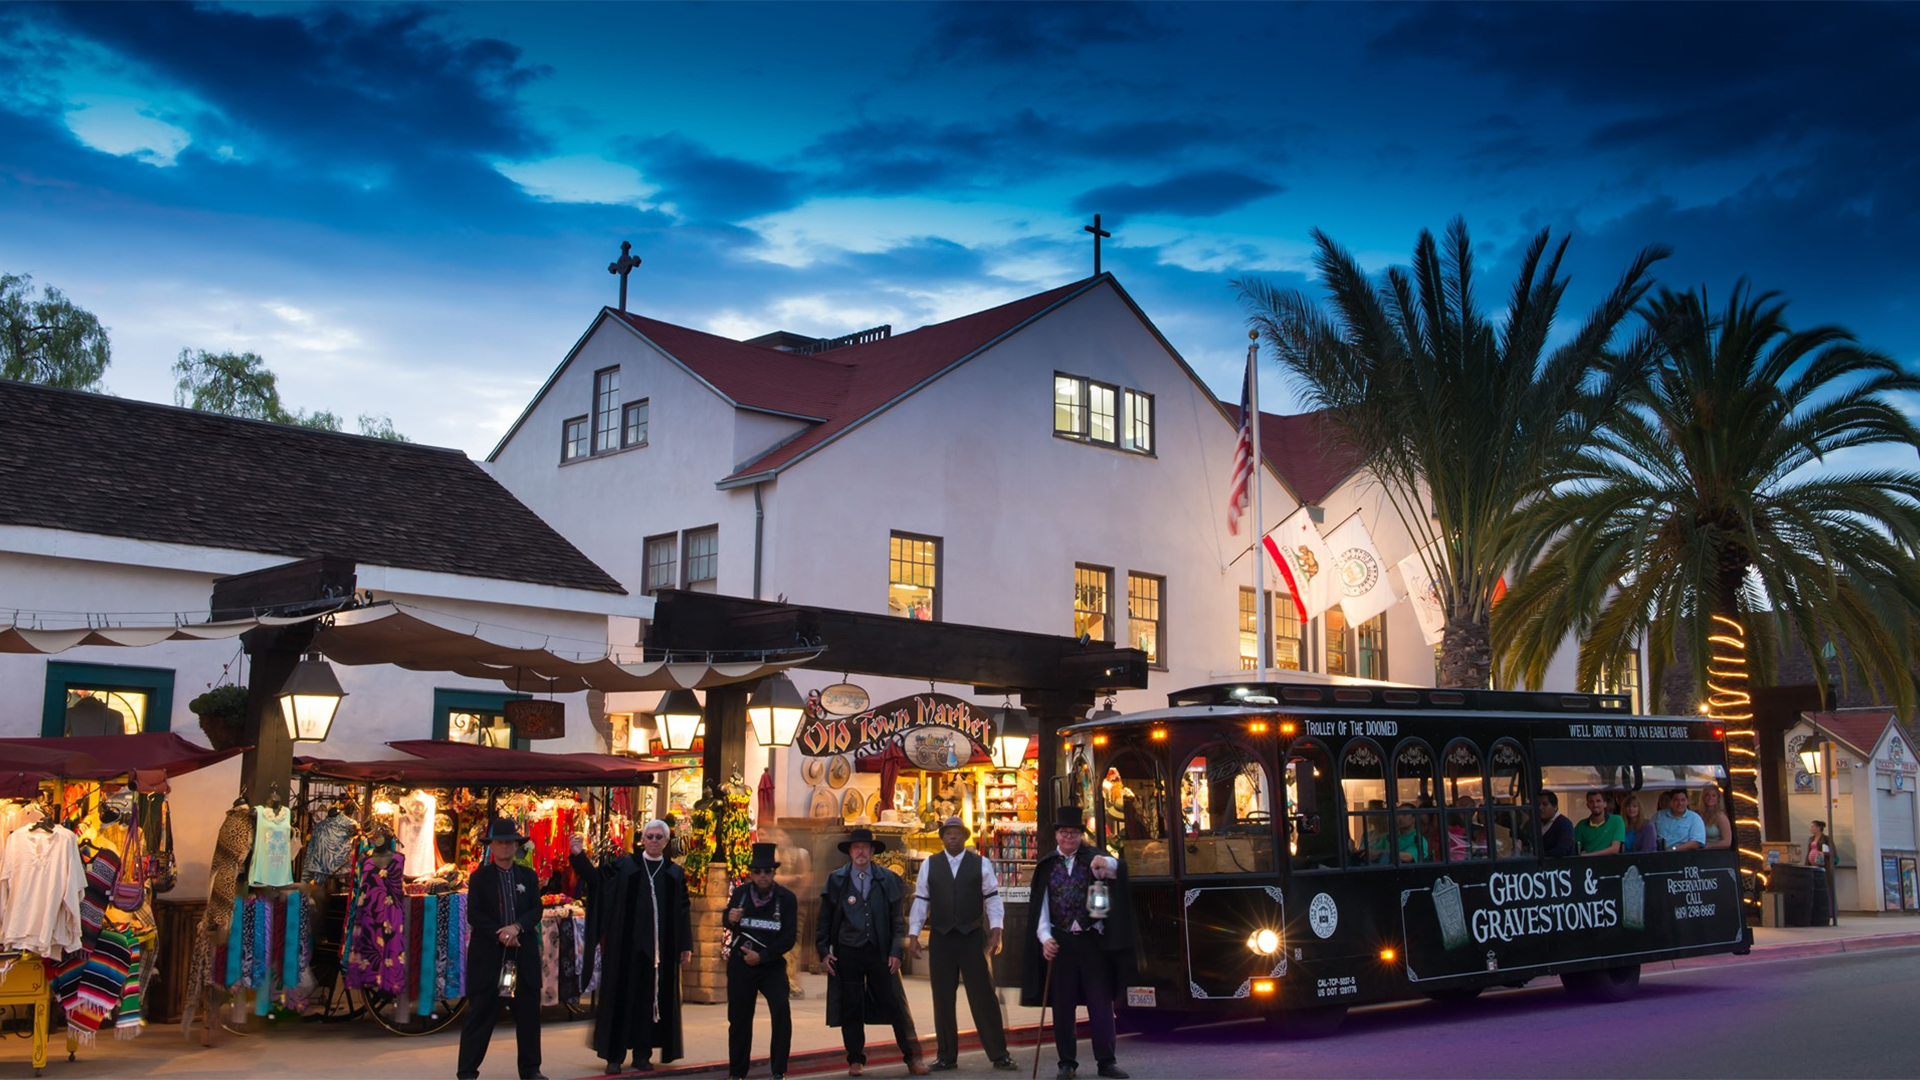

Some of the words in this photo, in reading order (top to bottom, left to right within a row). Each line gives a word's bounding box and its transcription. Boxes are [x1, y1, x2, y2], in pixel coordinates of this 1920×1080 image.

[804, 719, 851, 754] Old
[852, 709, 910, 744] Town
[914, 696, 991, 749] Market
[1304, 720, 1336, 736] TROLLEY
[1338, 720, 1347, 736] OF
[1350, 720, 1364, 736] THE
[1366, 720, 1398, 736] DOOMED
[1592, 725, 1612, 738] DRIVE
[1614, 725, 1627, 738] YOU
[1628, 726, 1637, 738] TO
[1639, 726, 1648, 738] AN
[1650, 726, 1668, 738] EARLY
[1669, 726, 1688, 738] GRAVE
[1684, 866, 1700, 879] FOR
[1489, 869, 1572, 906] GHOSTS
[1584, 868, 1598, 895] &
[1667, 878, 1718, 895] RESERVATIONS
[1686, 892, 1703, 904] CALL
[1472, 899, 1617, 943] GRAVESTONES
[1317, 989, 1325, 997] US
[1327, 988, 1338, 996] DOT
